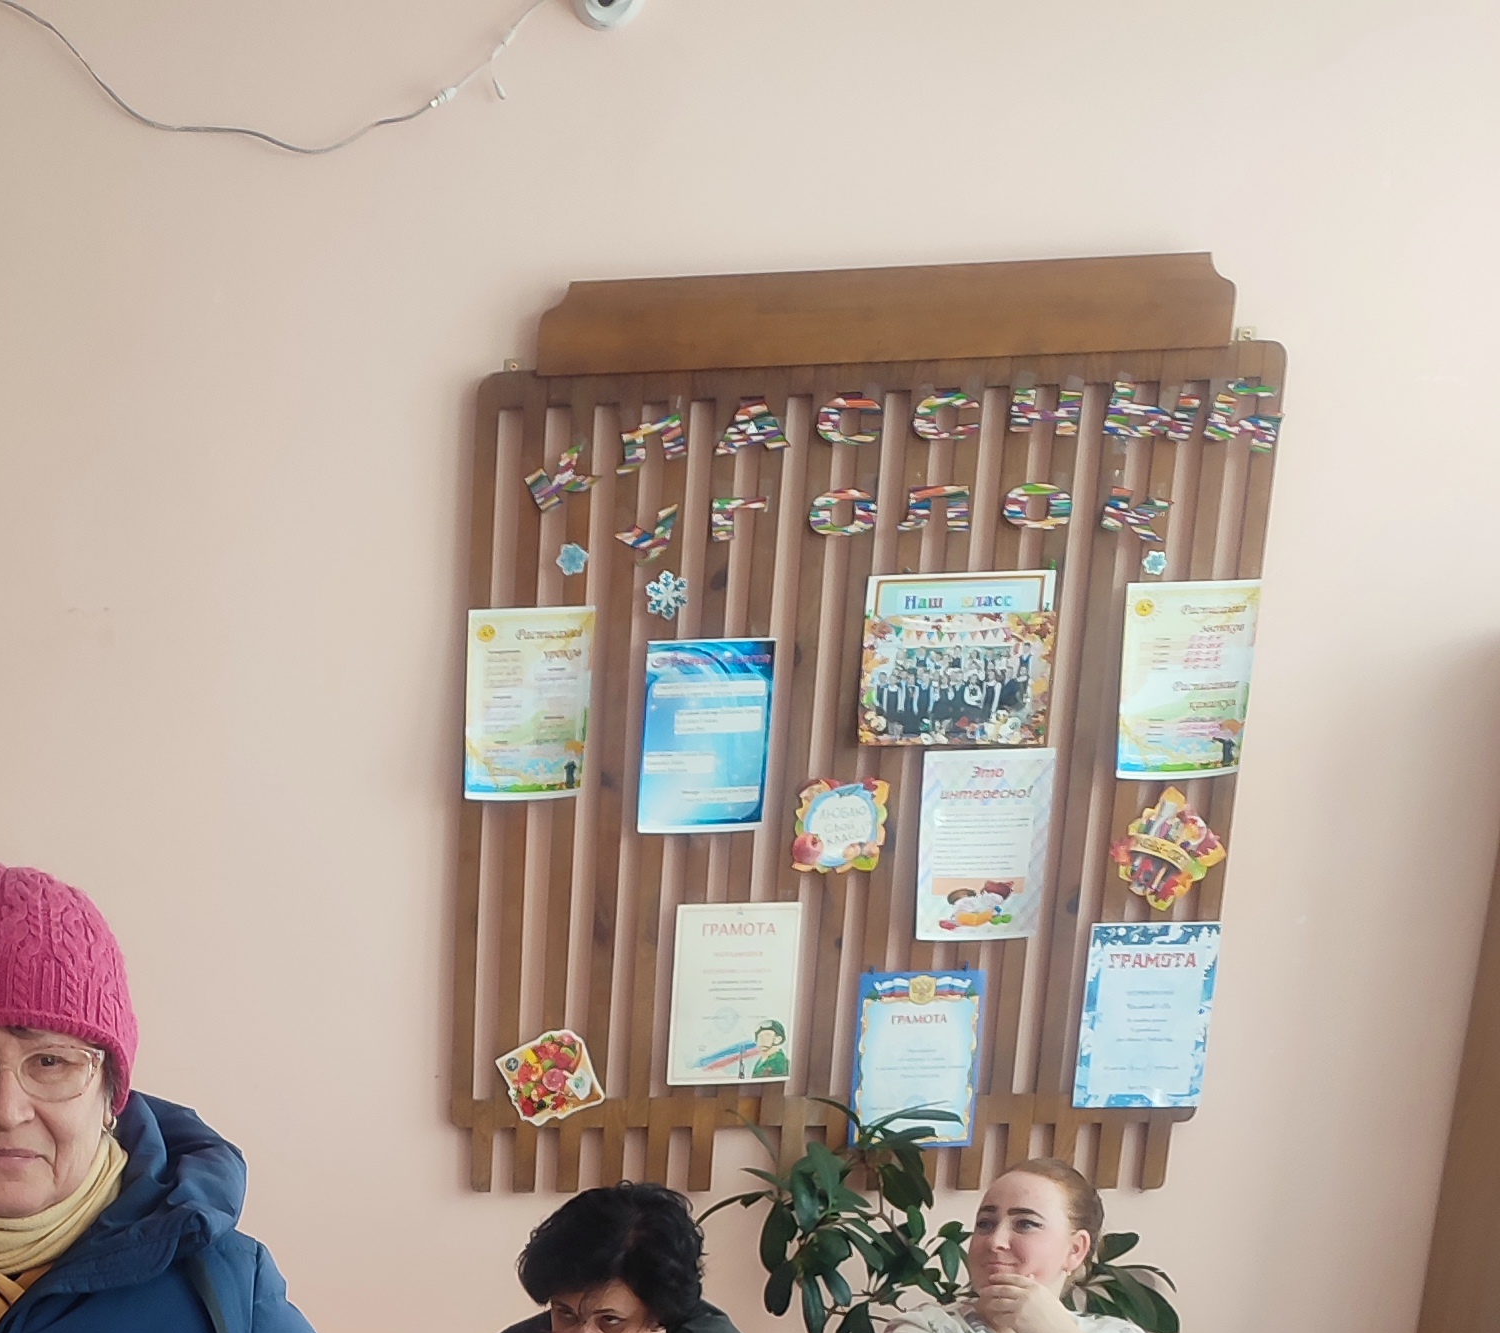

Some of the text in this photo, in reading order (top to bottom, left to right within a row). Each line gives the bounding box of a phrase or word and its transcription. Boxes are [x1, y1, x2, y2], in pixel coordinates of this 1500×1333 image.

[702, 922, 776, 937] ГРАМОТА
[1108, 952, 1197, 969] ГРАМОТА
[891, 1013, 948, 1025] ГРАМОТА
